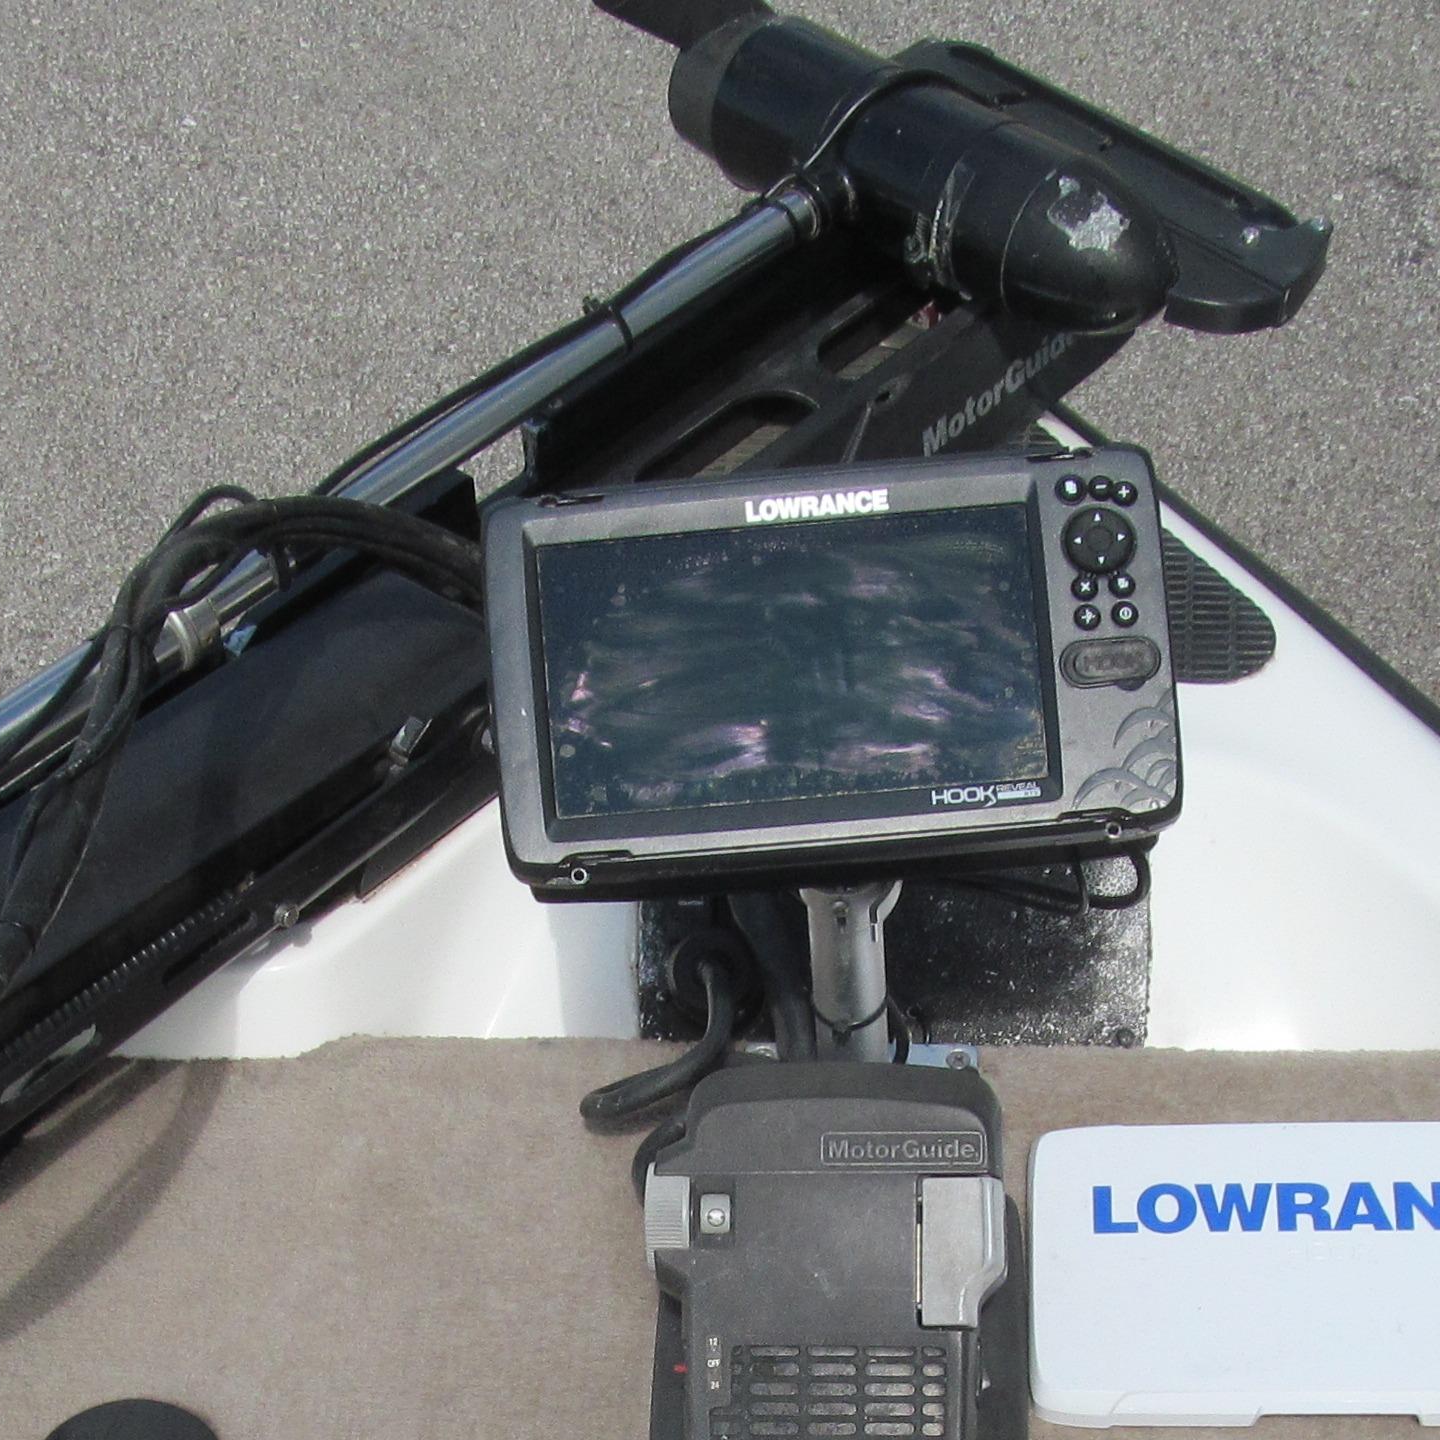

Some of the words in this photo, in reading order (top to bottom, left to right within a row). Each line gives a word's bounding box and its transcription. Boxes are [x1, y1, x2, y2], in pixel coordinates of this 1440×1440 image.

[745, 488, 890, 523] LOWRANCE
[931, 785, 997, 807] HOOK
[828, 1139, 976, 1159] MotorGuide
